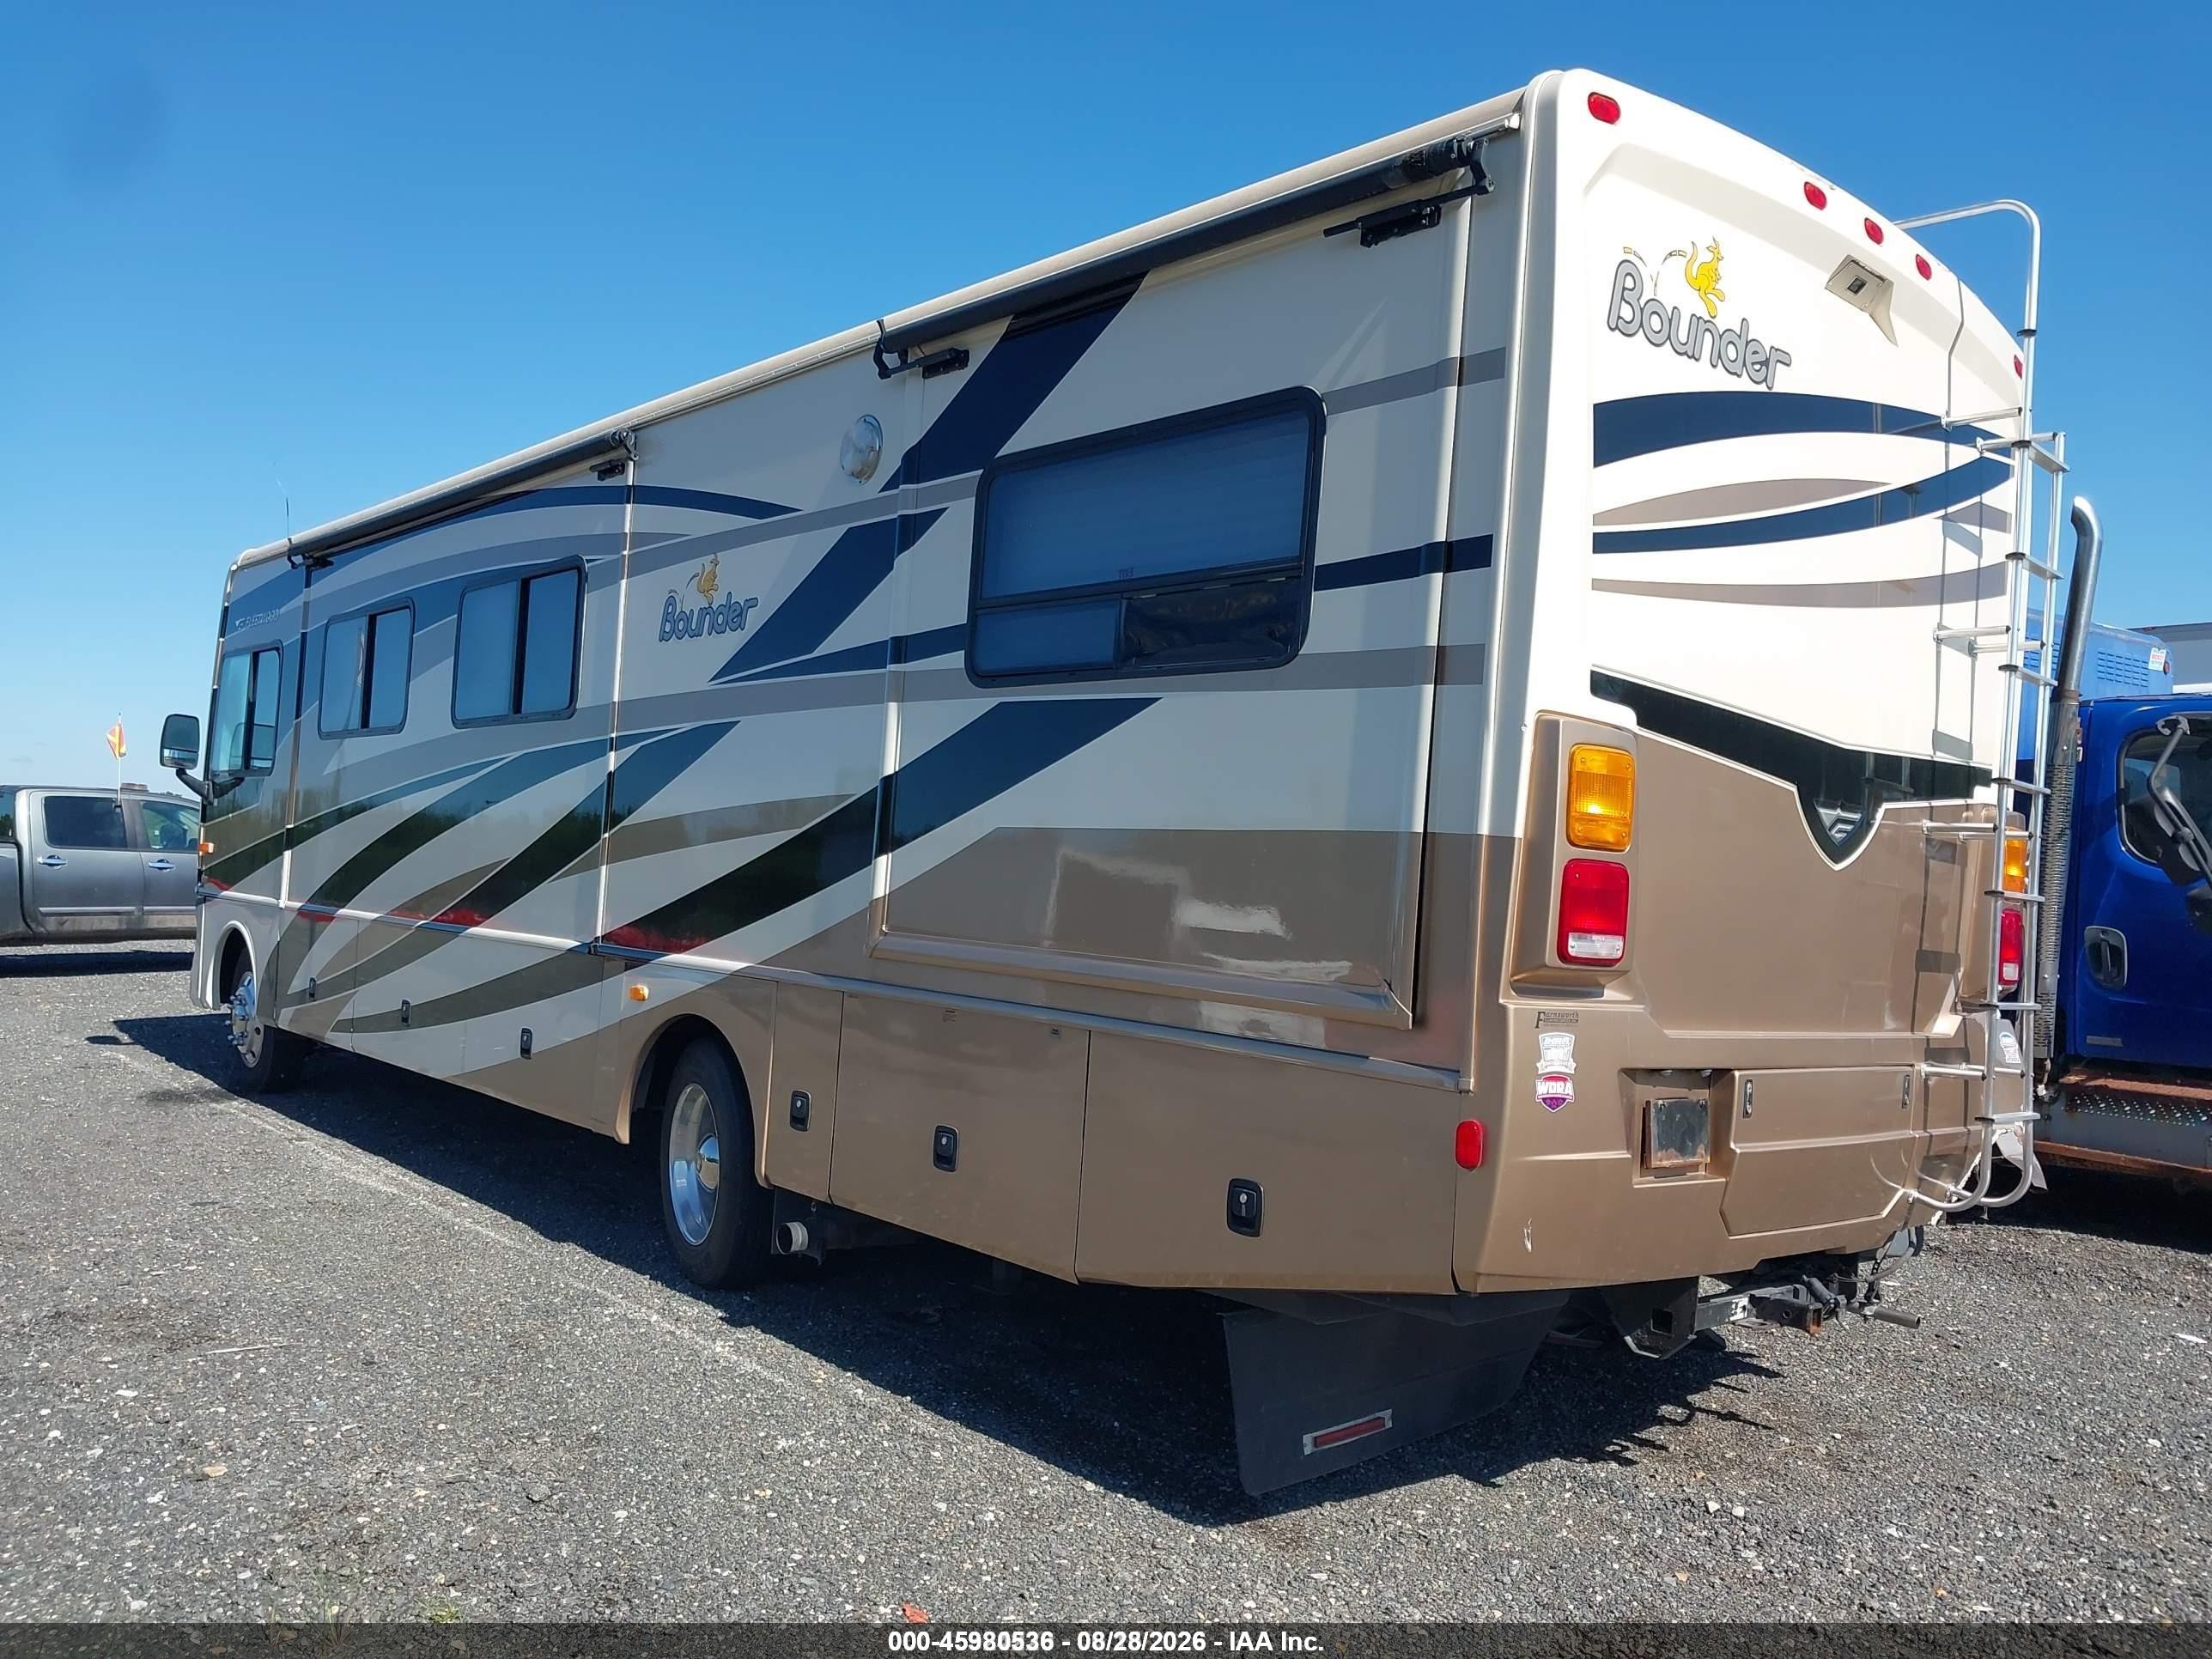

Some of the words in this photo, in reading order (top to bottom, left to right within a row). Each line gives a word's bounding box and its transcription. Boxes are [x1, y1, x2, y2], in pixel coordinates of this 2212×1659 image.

[1607, 258, 1791, 390] Bounder
[659, 592, 759, 642] Bounder
[1534, 1011, 1579, 1029] Farnsworth
[1537, 1080, 1573, 1096] WDRA
